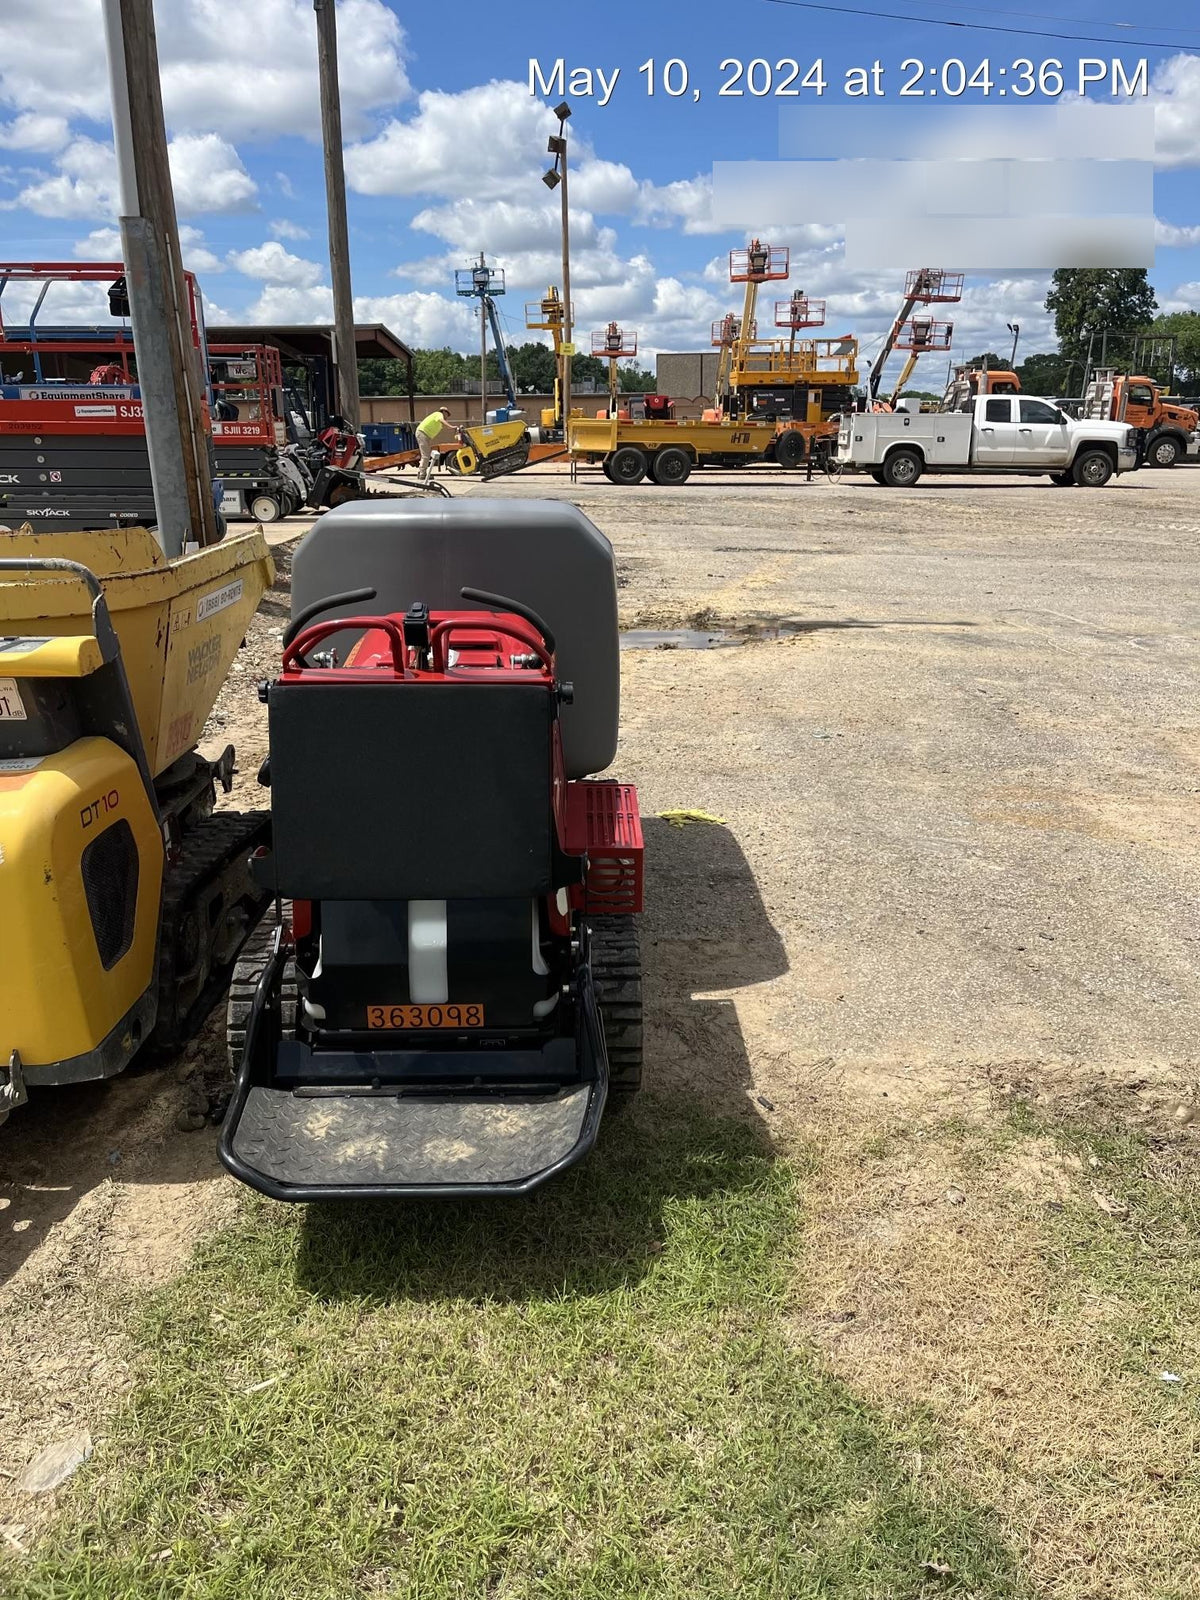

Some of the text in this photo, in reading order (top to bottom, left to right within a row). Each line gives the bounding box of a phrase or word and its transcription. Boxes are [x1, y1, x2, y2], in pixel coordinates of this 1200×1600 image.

[41, 391, 125, 400] EquipmentShare
[242, 426, 260, 435] 3219
[26, 507, 70, 517] SKYJACK
[80, 789, 119, 829] DT 10
[371, 1005, 481, 1028] 363098
